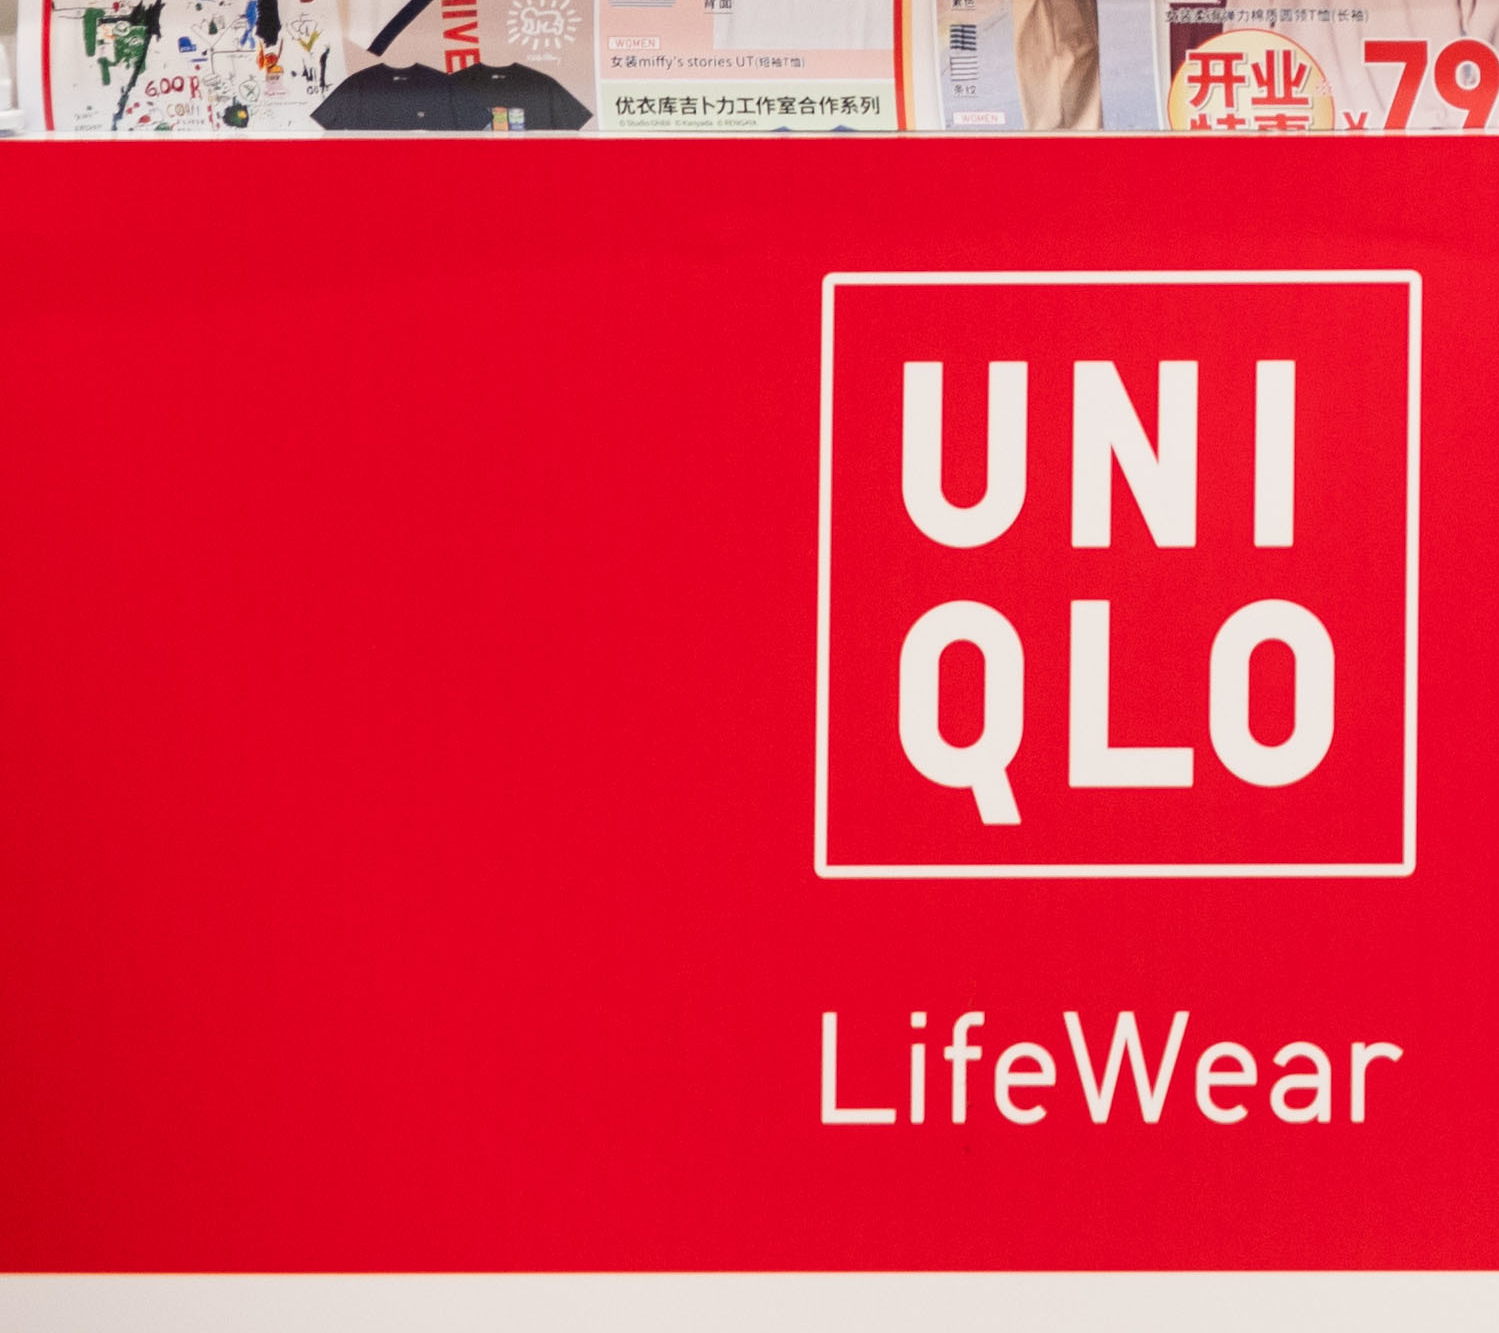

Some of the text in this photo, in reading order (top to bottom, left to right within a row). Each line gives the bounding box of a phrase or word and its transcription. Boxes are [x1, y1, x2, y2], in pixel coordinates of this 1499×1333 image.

[615, 38, 656, 49] WOMEN
[687, 55, 733, 68] stories
[615, 95, 881, 117] 优衣库吉卜力工作室合作系列
[1187, 49, 1311, 109] 开业
[901, 360, 1296, 548] UNI
[898, 599, 1335, 824] QLO
[820, 1010, 1404, 1126] LifeWear
